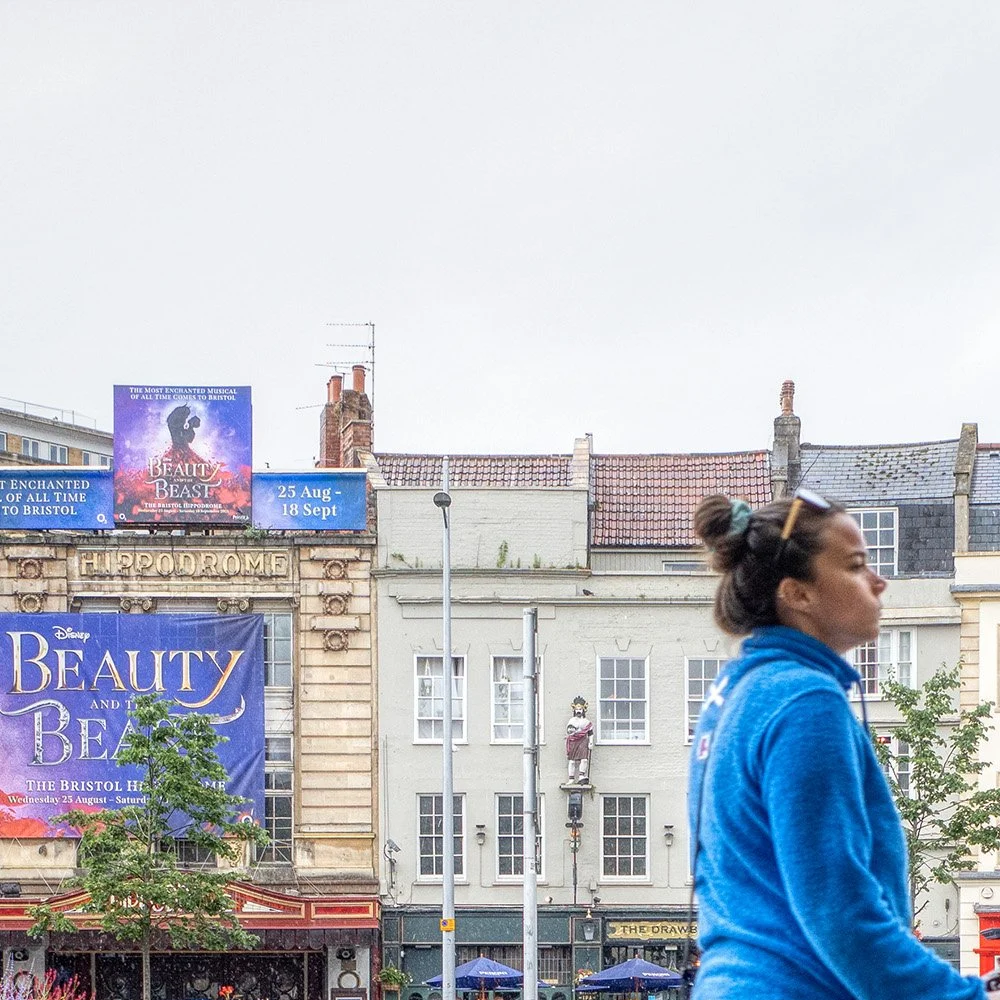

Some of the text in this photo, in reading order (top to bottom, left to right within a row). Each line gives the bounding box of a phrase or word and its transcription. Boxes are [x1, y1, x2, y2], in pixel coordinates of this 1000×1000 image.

[149, 457, 220, 482] BEAUTY
[11, 480, 90, 490] ENCHANTED
[144, 478, 222, 500] BEAST
[6, 492, 87, 502] OF ALL TIME
[278, 486, 296, 498] 25
[300, 486, 332, 502] Aug
[2, 505, 77, 515] TO BRISTOL
[282, 504, 338, 520] 18 Sept
[80, 552, 288, 576] HIPPODROME
[52, 626, 90, 643] Disney
[5, 631, 245, 709] BEAUTY
[90, 700, 120, 710] AND
[26, 780, 56, 792] THE
[60, 780, 122, 792] BRISTOL
[8, 796, 60, 805] Wednesday
[62, 796, 72, 804] 25
[75, 796, 107, 806] August
[620, 926, 647, 934] THE
